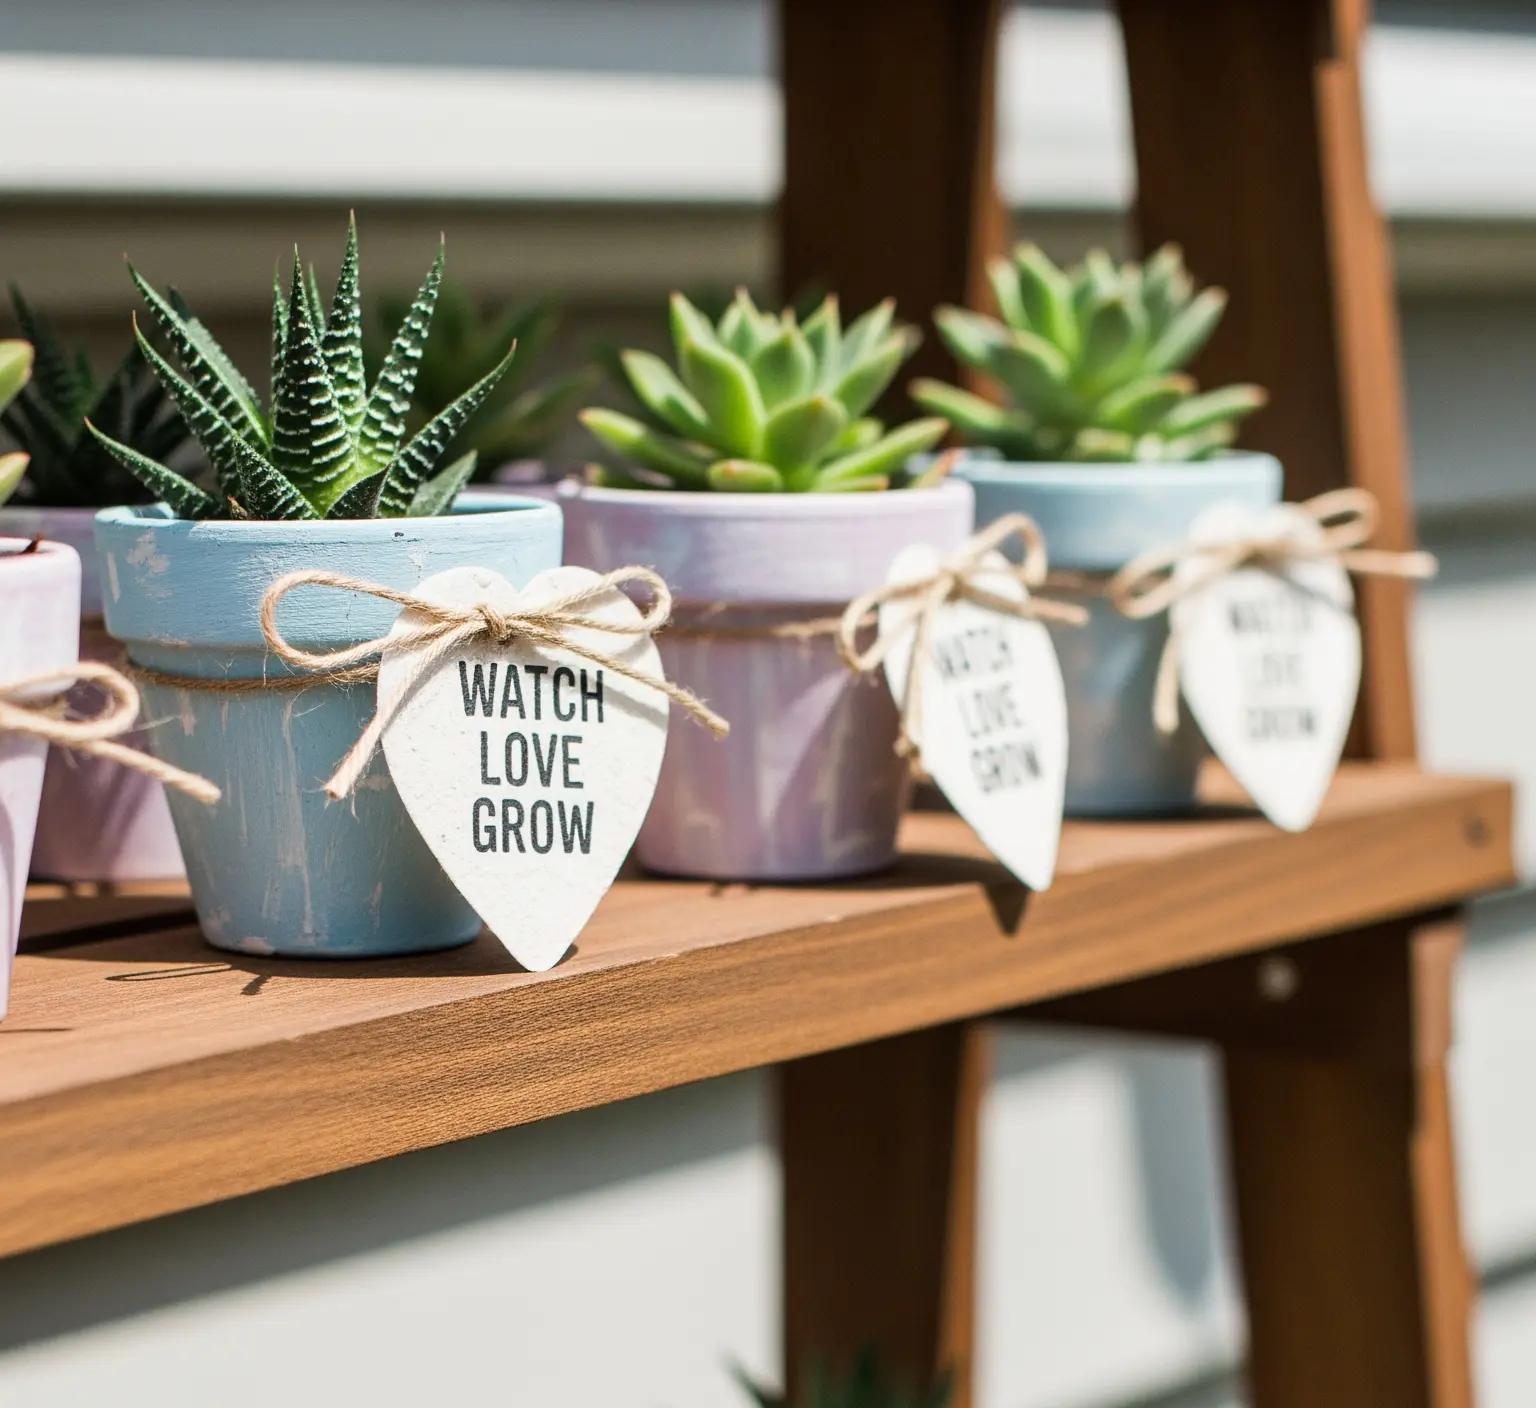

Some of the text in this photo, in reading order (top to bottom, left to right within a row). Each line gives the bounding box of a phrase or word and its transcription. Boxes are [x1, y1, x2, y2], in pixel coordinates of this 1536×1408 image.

[459, 661, 604, 724] WATCH
[480, 731, 584, 789] LOVE
[472, 797, 594, 855] GROW
